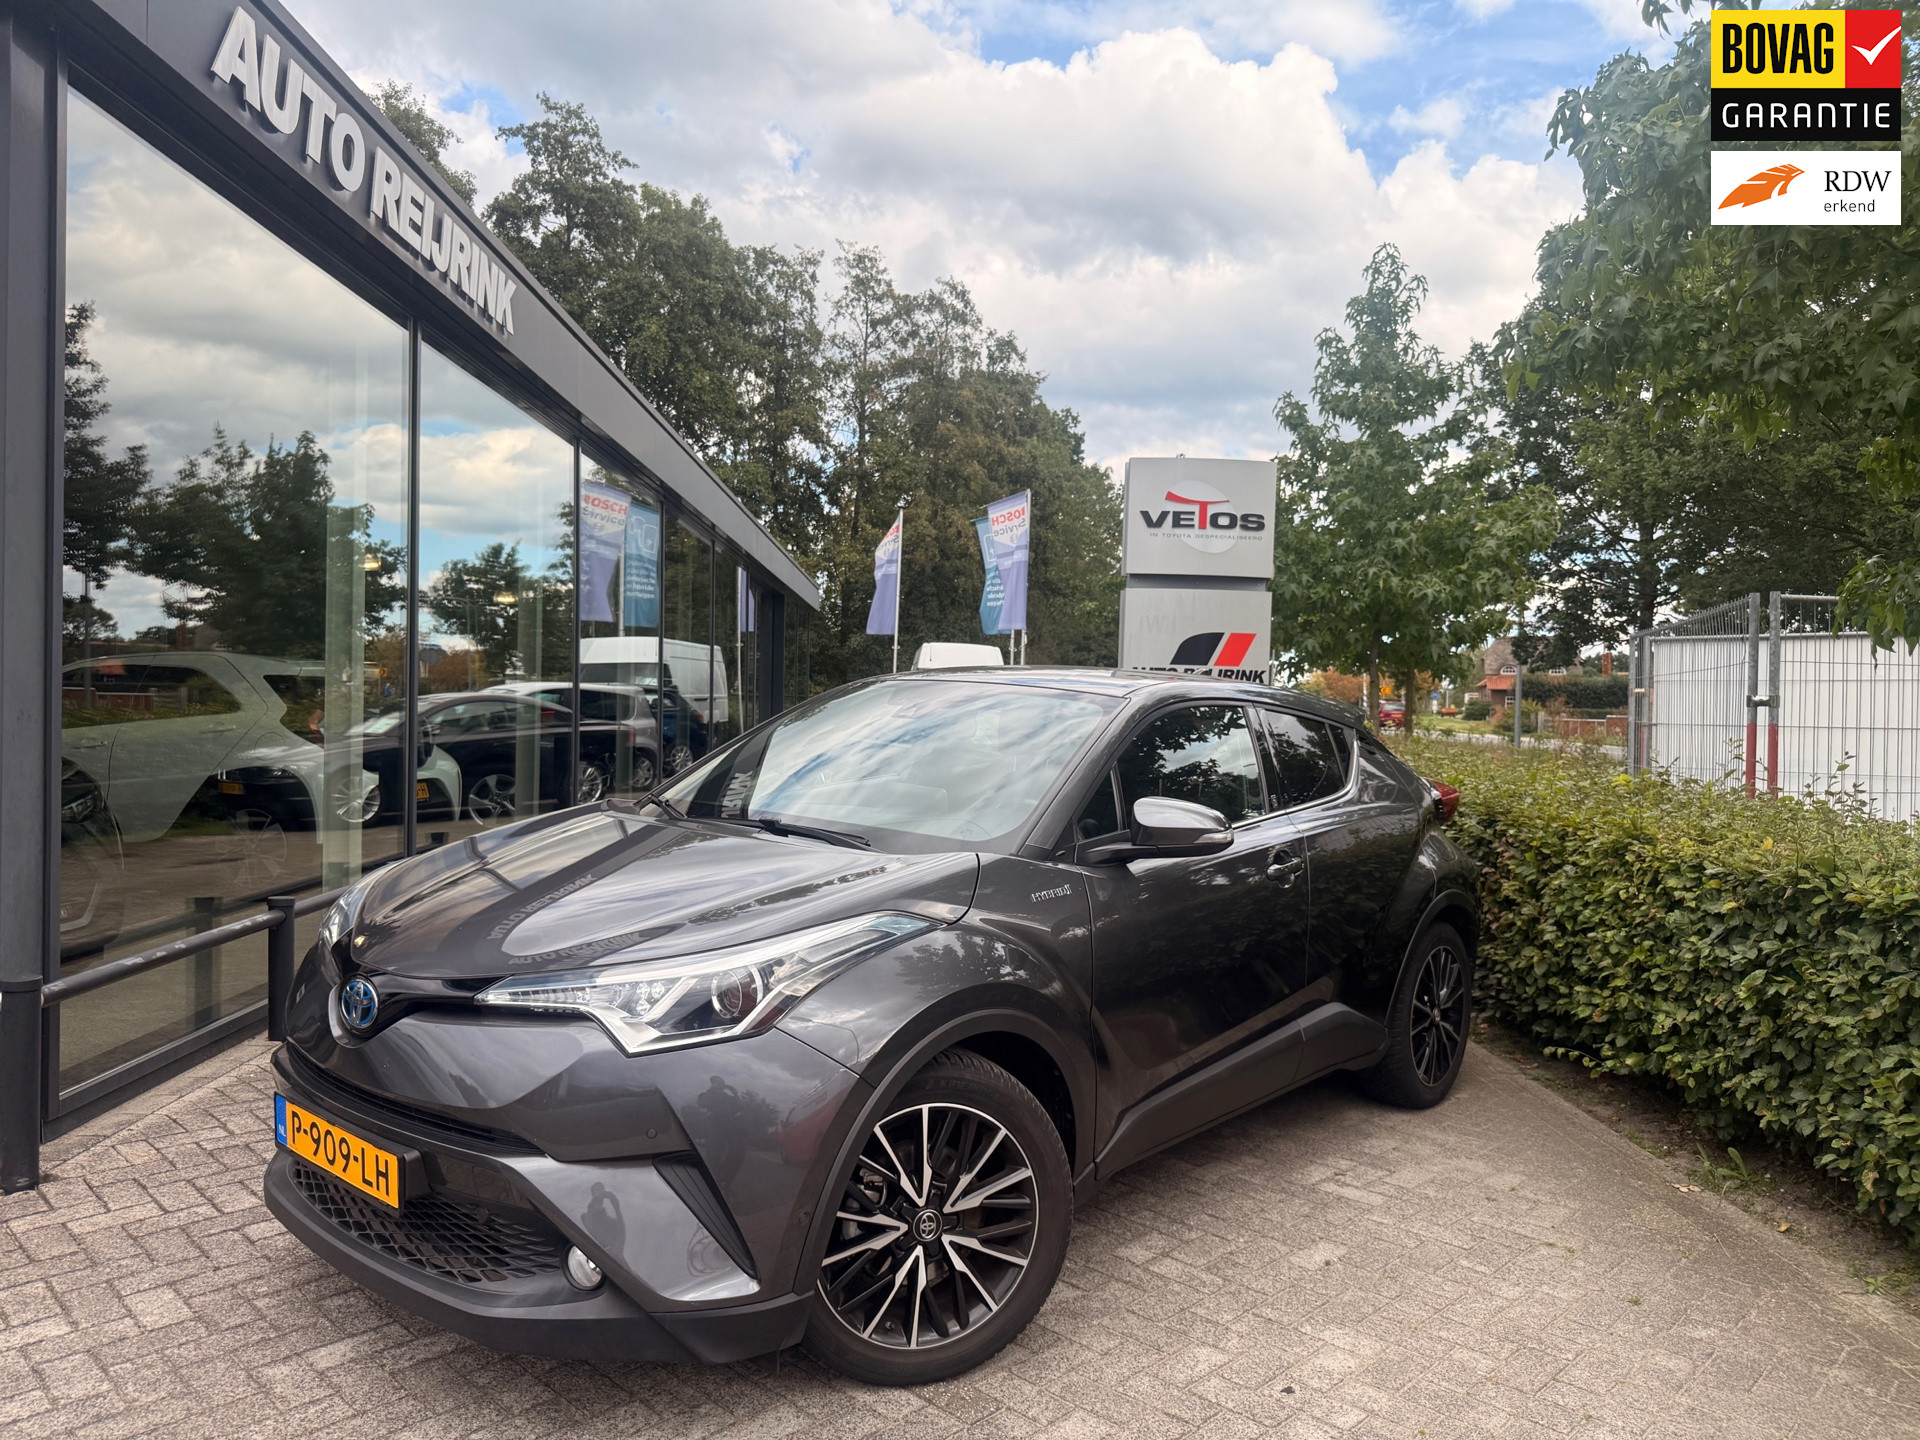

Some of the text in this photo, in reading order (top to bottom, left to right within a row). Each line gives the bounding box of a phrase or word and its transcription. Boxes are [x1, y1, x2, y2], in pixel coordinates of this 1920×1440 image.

[211, 6, 517, 336] AUTO REIJRINK
[1031, 887, 1067, 902] HYBRID
[278, 1123, 287, 1137] NL
[291, 1110, 390, 1197] P-909-LH
